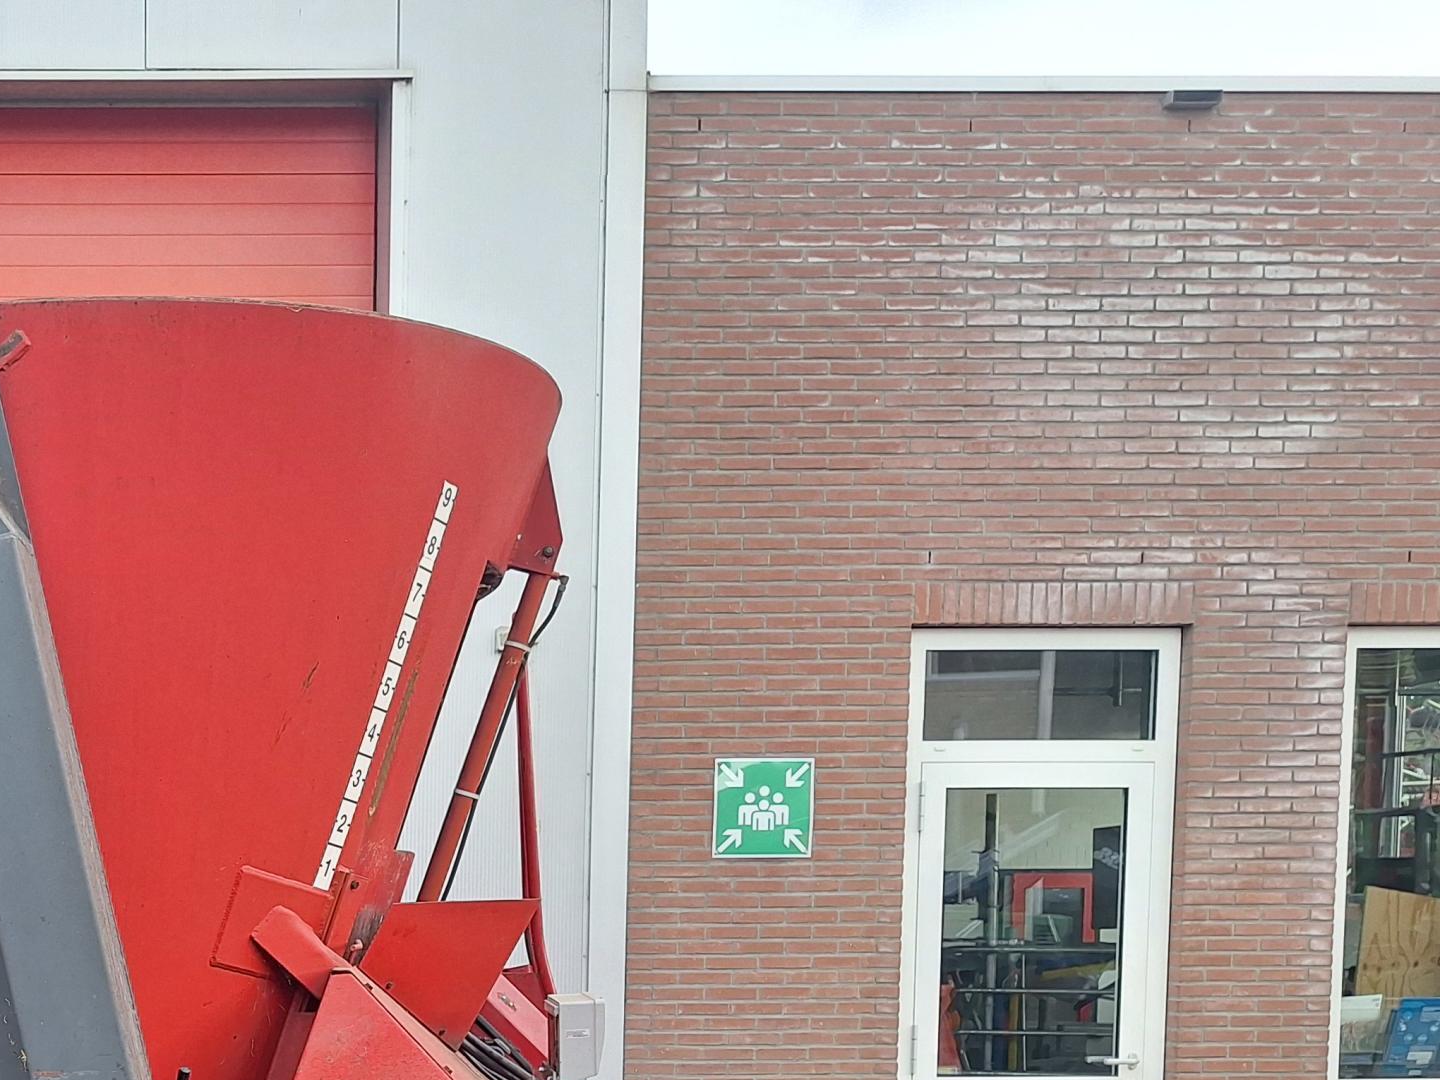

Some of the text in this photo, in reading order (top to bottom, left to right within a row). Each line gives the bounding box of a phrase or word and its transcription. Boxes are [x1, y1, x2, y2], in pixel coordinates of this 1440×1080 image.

[441, 487, 453, 508] 9
[426, 535, 437, 555] 8
[412, 582, 423, 602] 7
[396, 630, 407, 650] 6
[381, 676, 393, 696] 5
[367, 723, 378, 743] 4
[352, 769, 363, 788] 3
[336, 813, 348, 833] 2
[323, 859, 333, 877] 1
